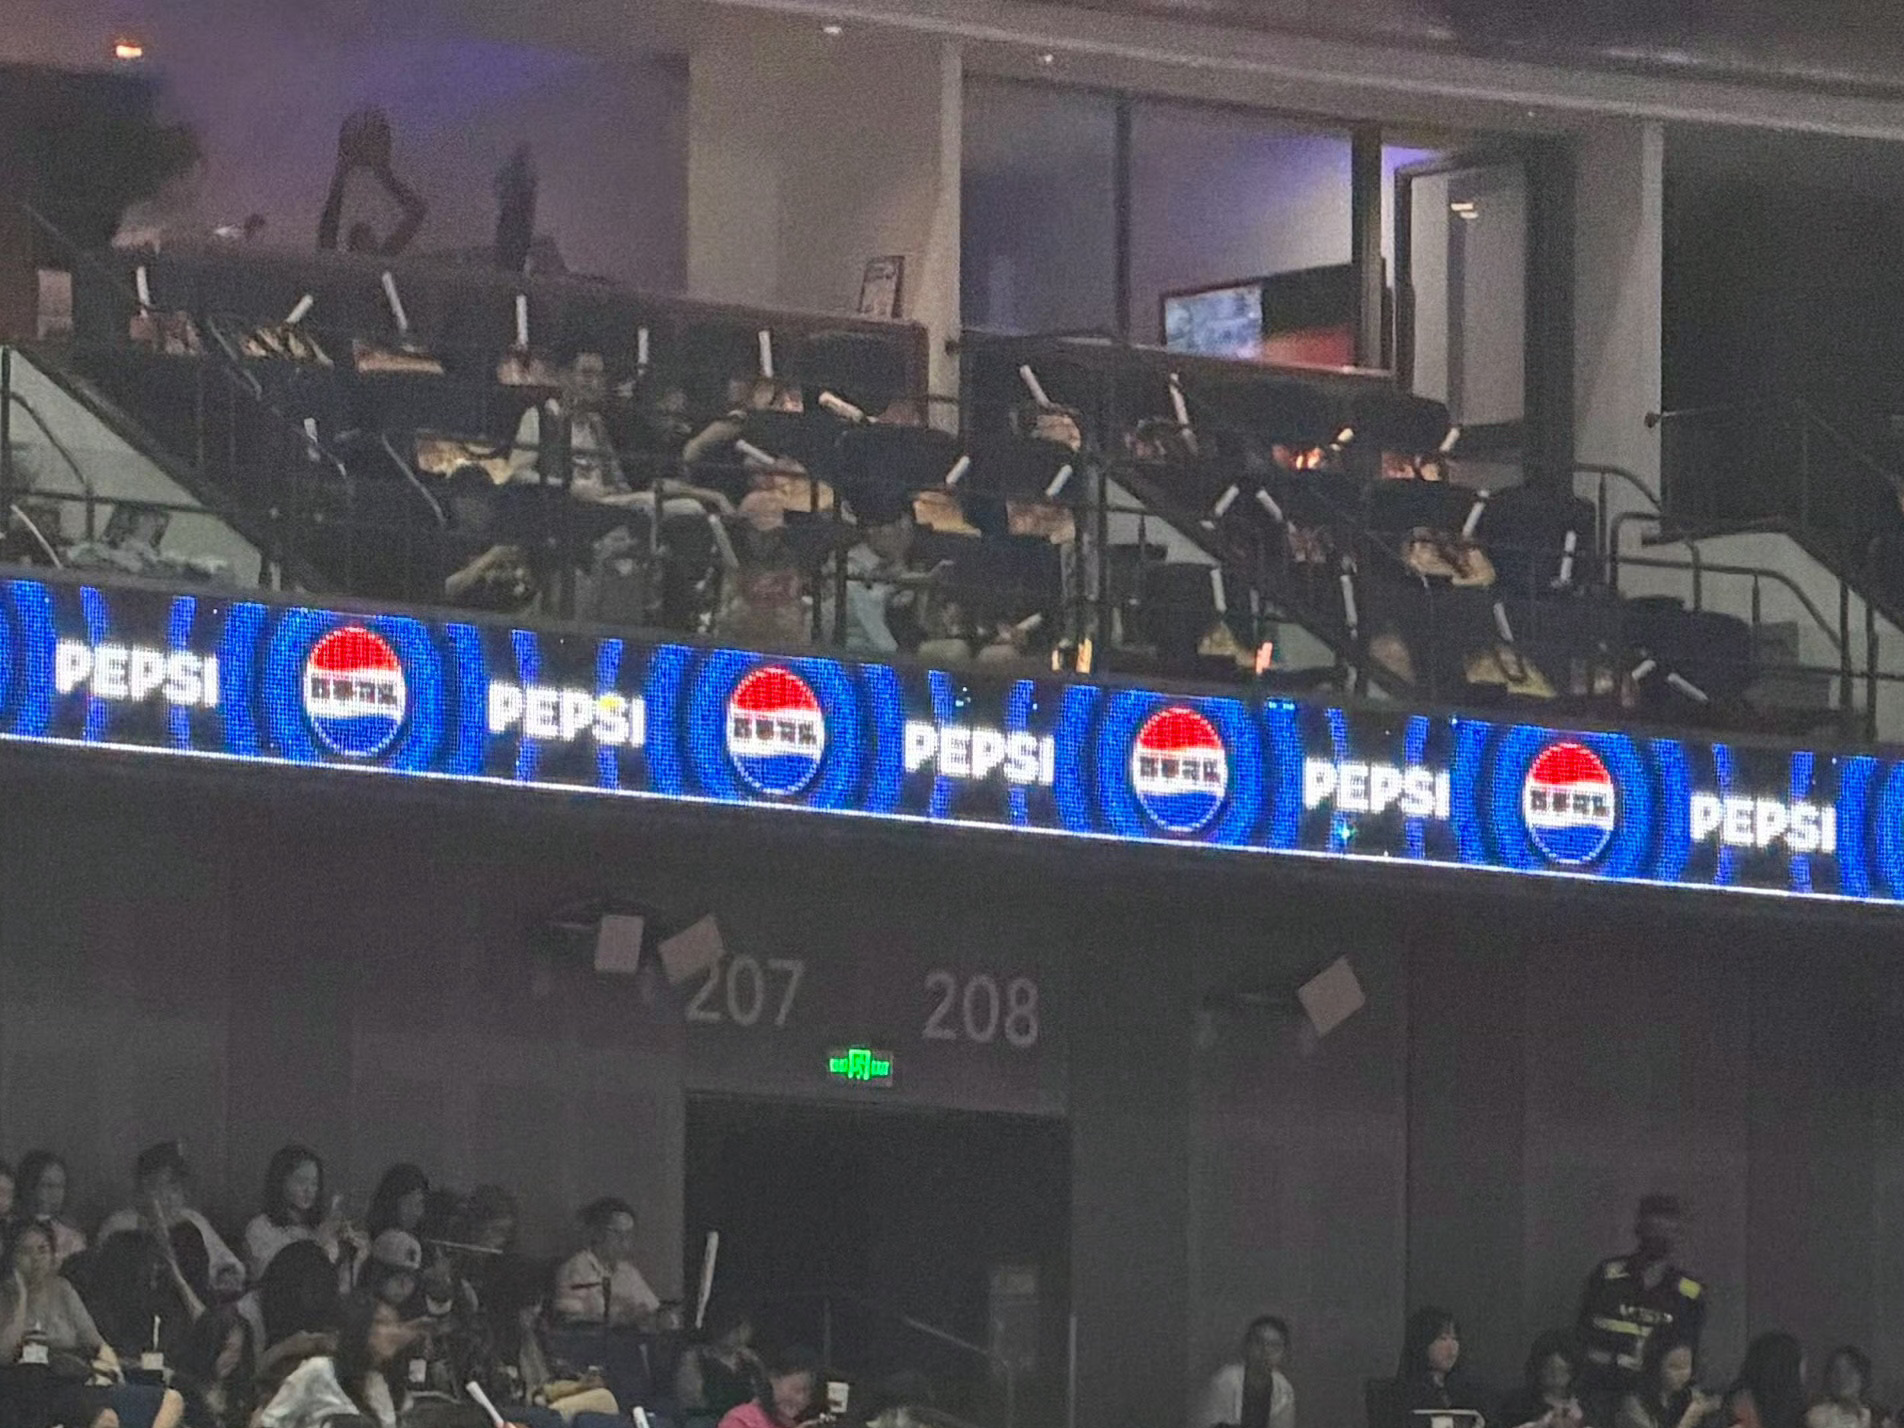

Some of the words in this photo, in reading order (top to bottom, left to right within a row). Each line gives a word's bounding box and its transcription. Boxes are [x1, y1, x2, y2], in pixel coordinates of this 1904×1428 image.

[55, 639, 219, 707] PEPSI
[488, 680, 645, 748] PEPSI
[904, 720, 1054, 785] PEPSI
[1304, 757, 1449, 819] PEPSI
[1691, 792, 1836, 853] PEPSI
[685, 955, 804, 1028] 207
[922, 968, 1039, 1048] 208
